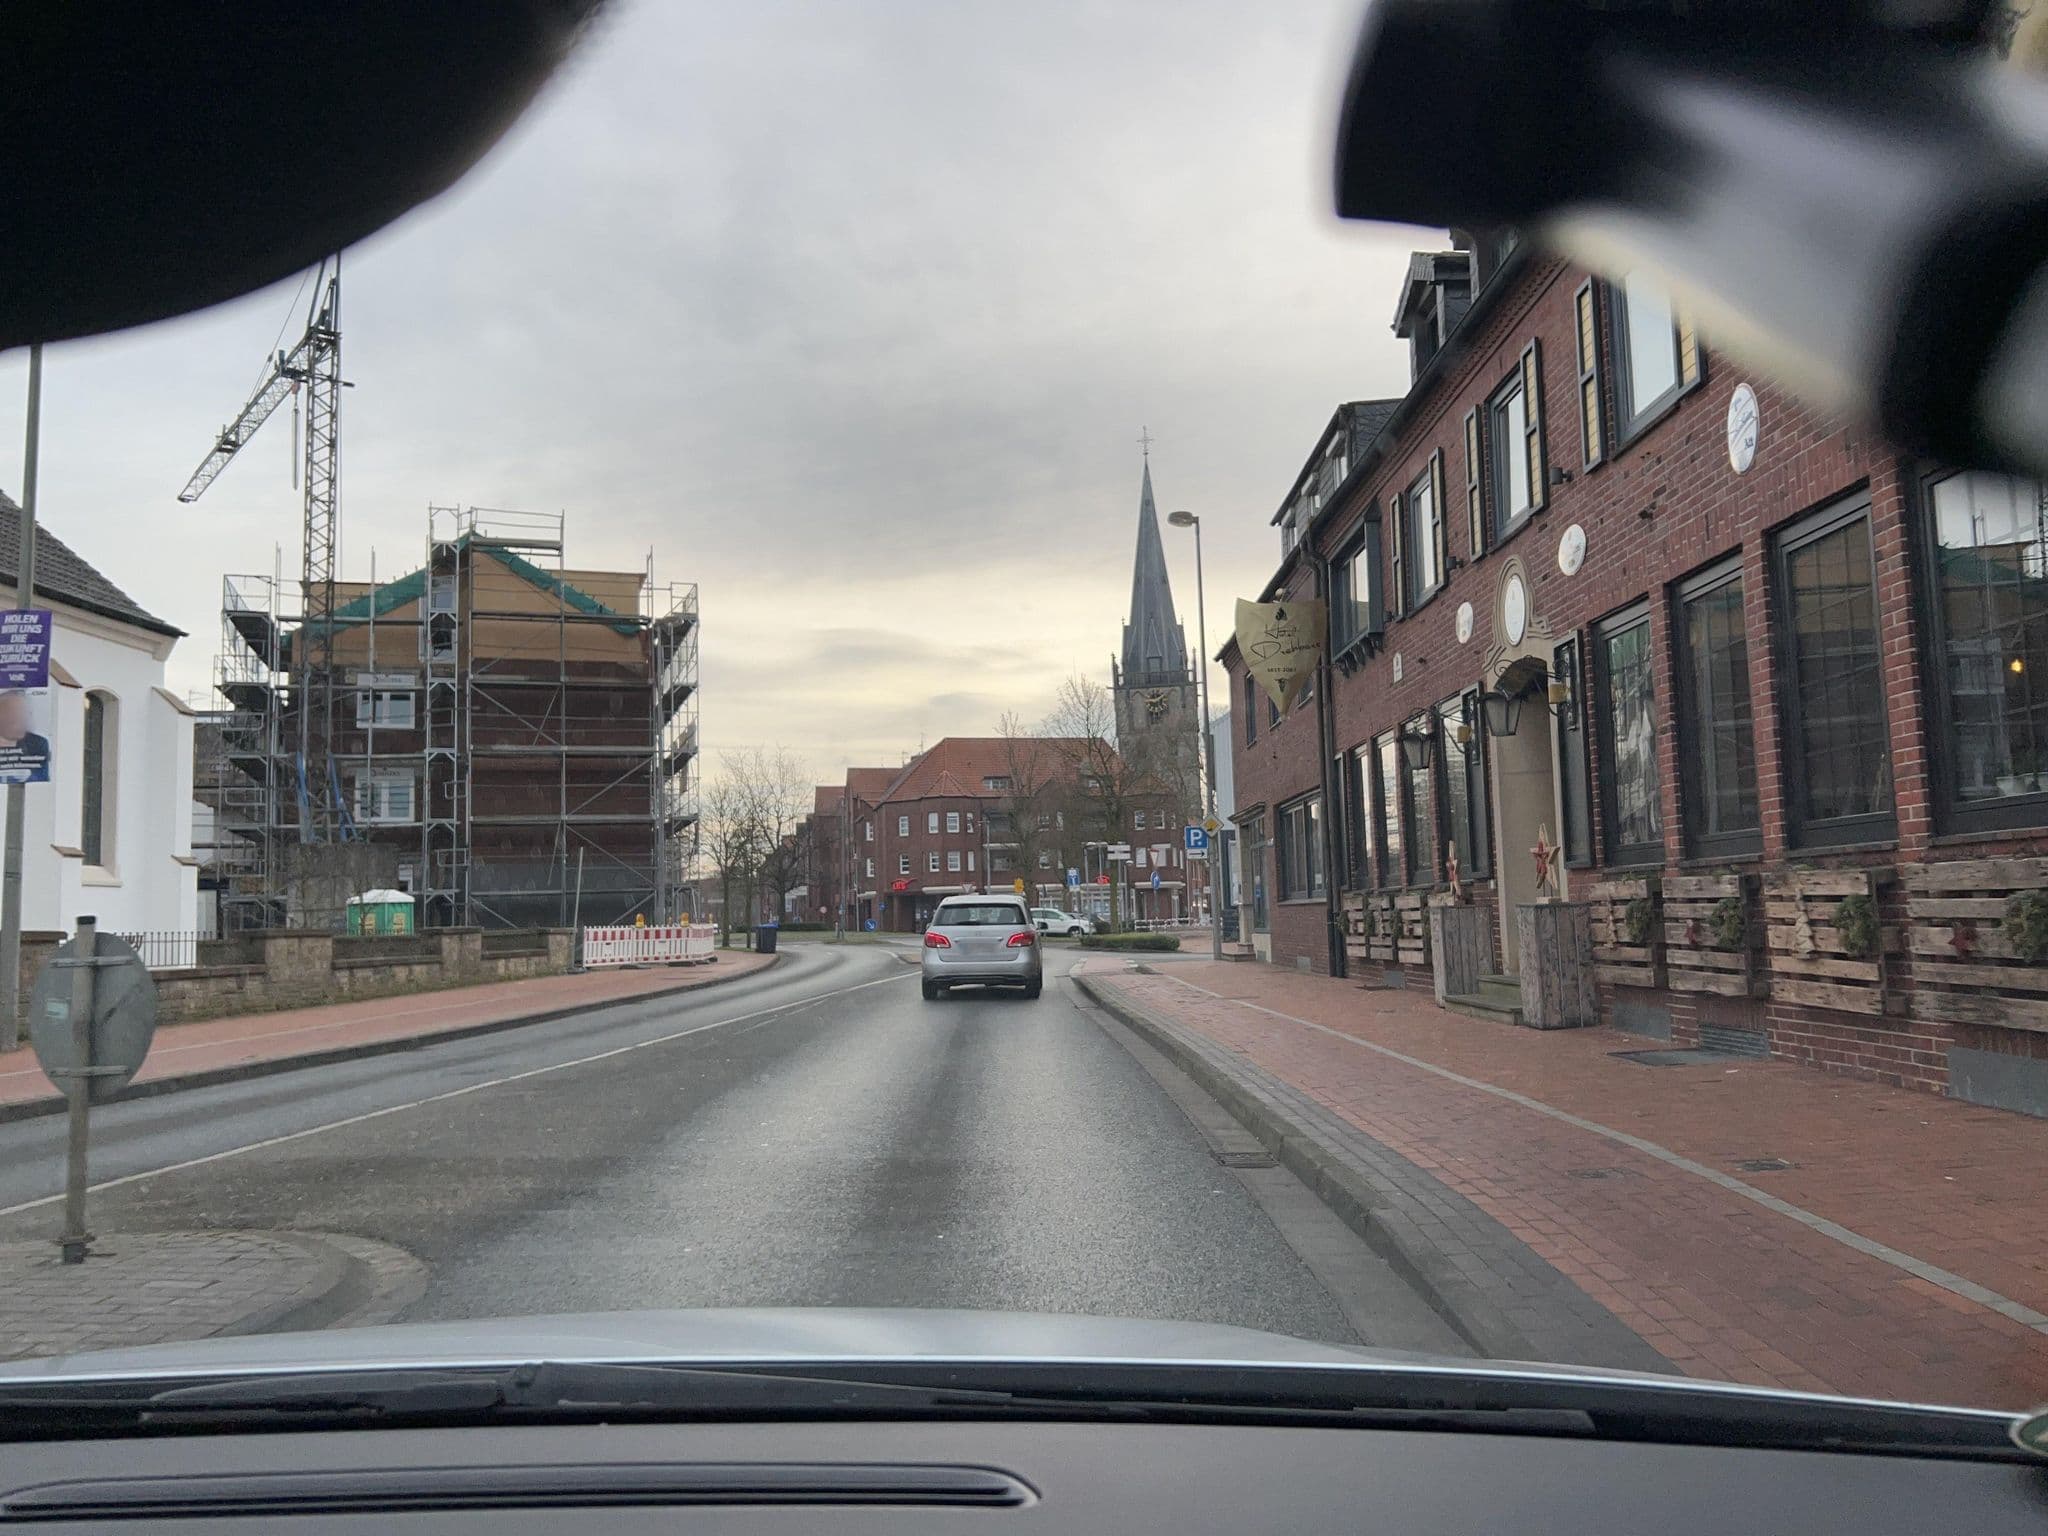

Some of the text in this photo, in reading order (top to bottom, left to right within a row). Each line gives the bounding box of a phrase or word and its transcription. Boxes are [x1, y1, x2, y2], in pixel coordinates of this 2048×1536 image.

[4, 614, 39, 624] HOLEN
[1, 624, 43, 634] WIR UNS
[10, 634, 28, 643] DIE
[9, 673, 26, 681] Volt
